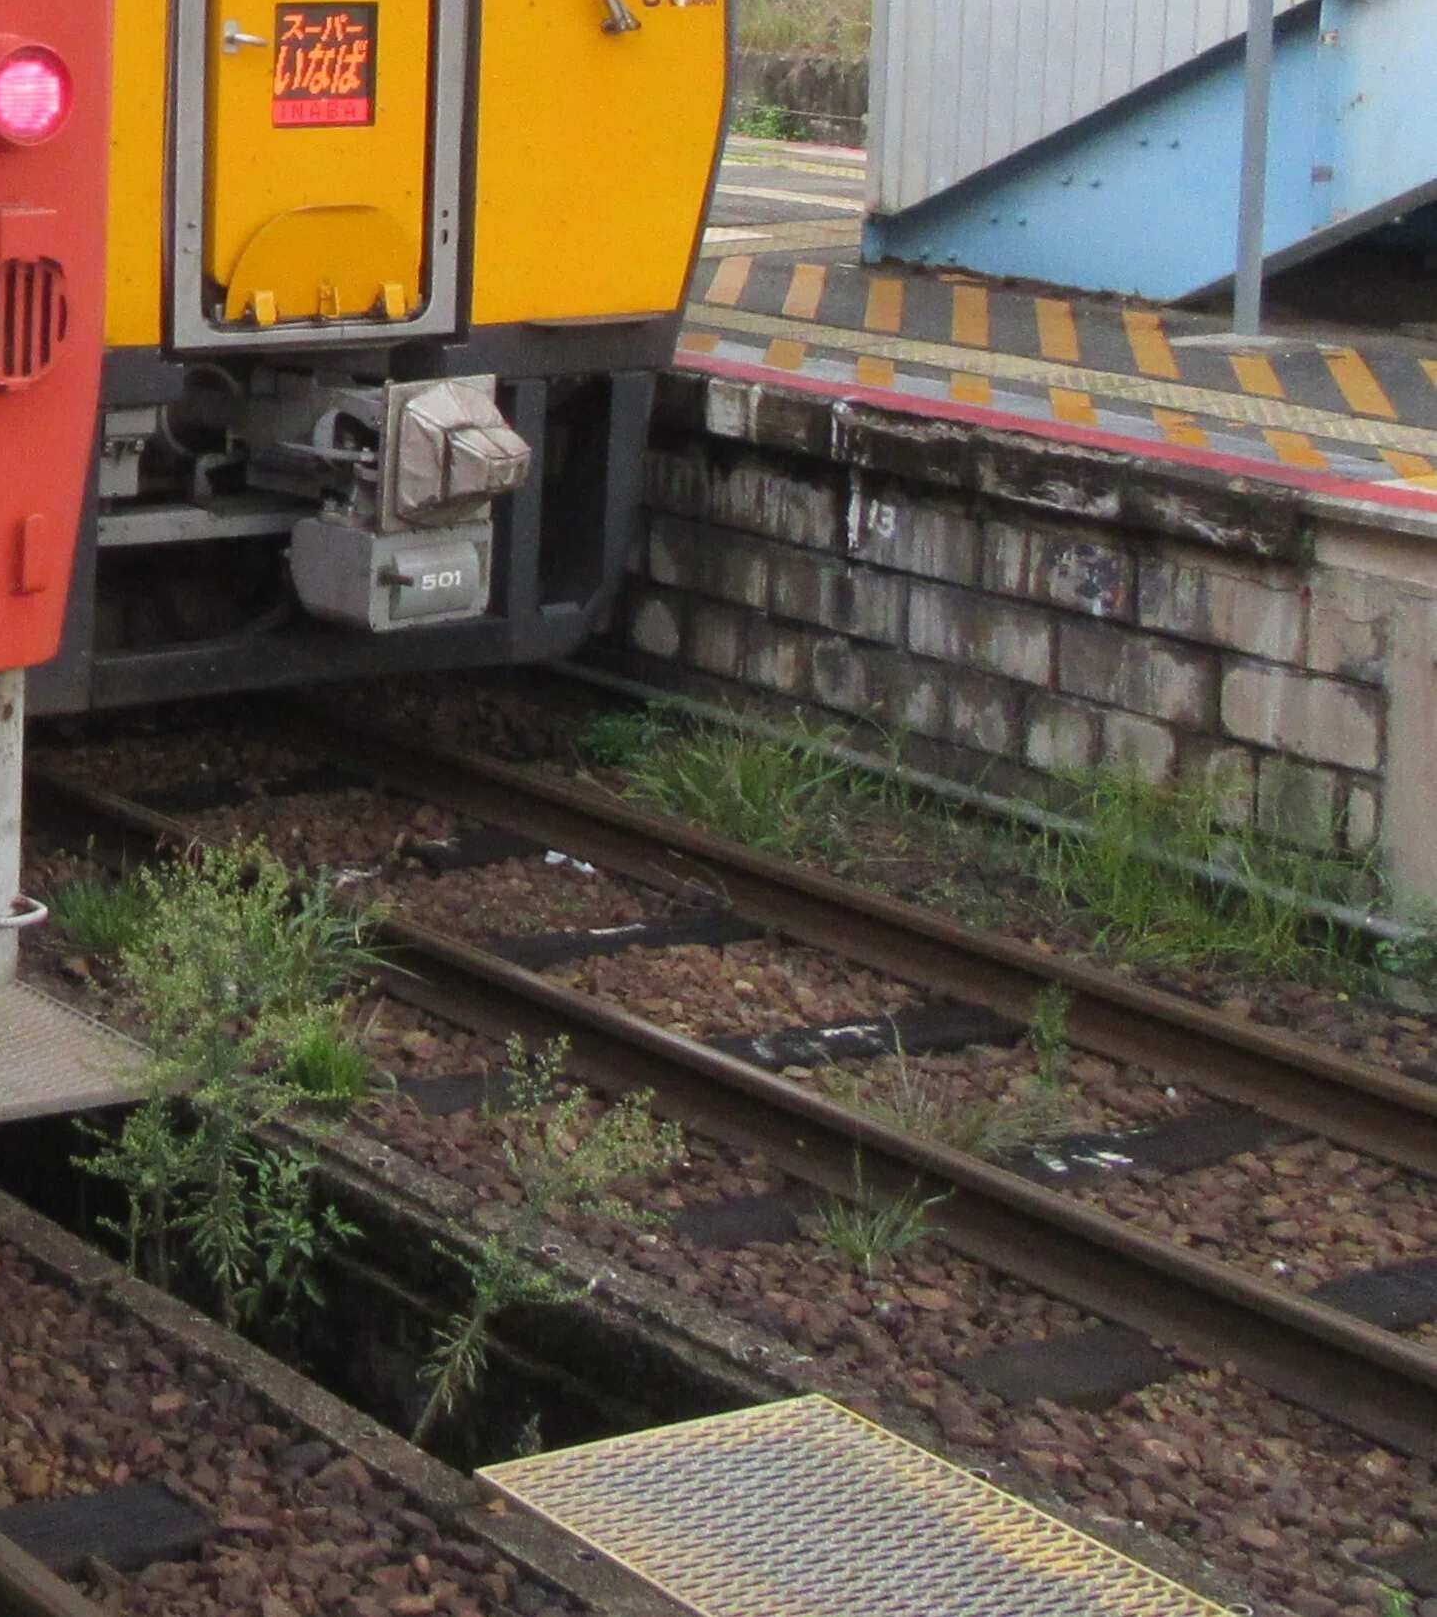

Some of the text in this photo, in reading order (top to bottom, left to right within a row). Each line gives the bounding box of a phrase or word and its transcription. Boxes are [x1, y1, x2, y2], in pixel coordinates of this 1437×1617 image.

[280, 13, 364, 42] スーパー
[273, 39, 369, 95] いなば
[280, 102, 356, 120] INABA
[421, 569, 462, 591] 501
